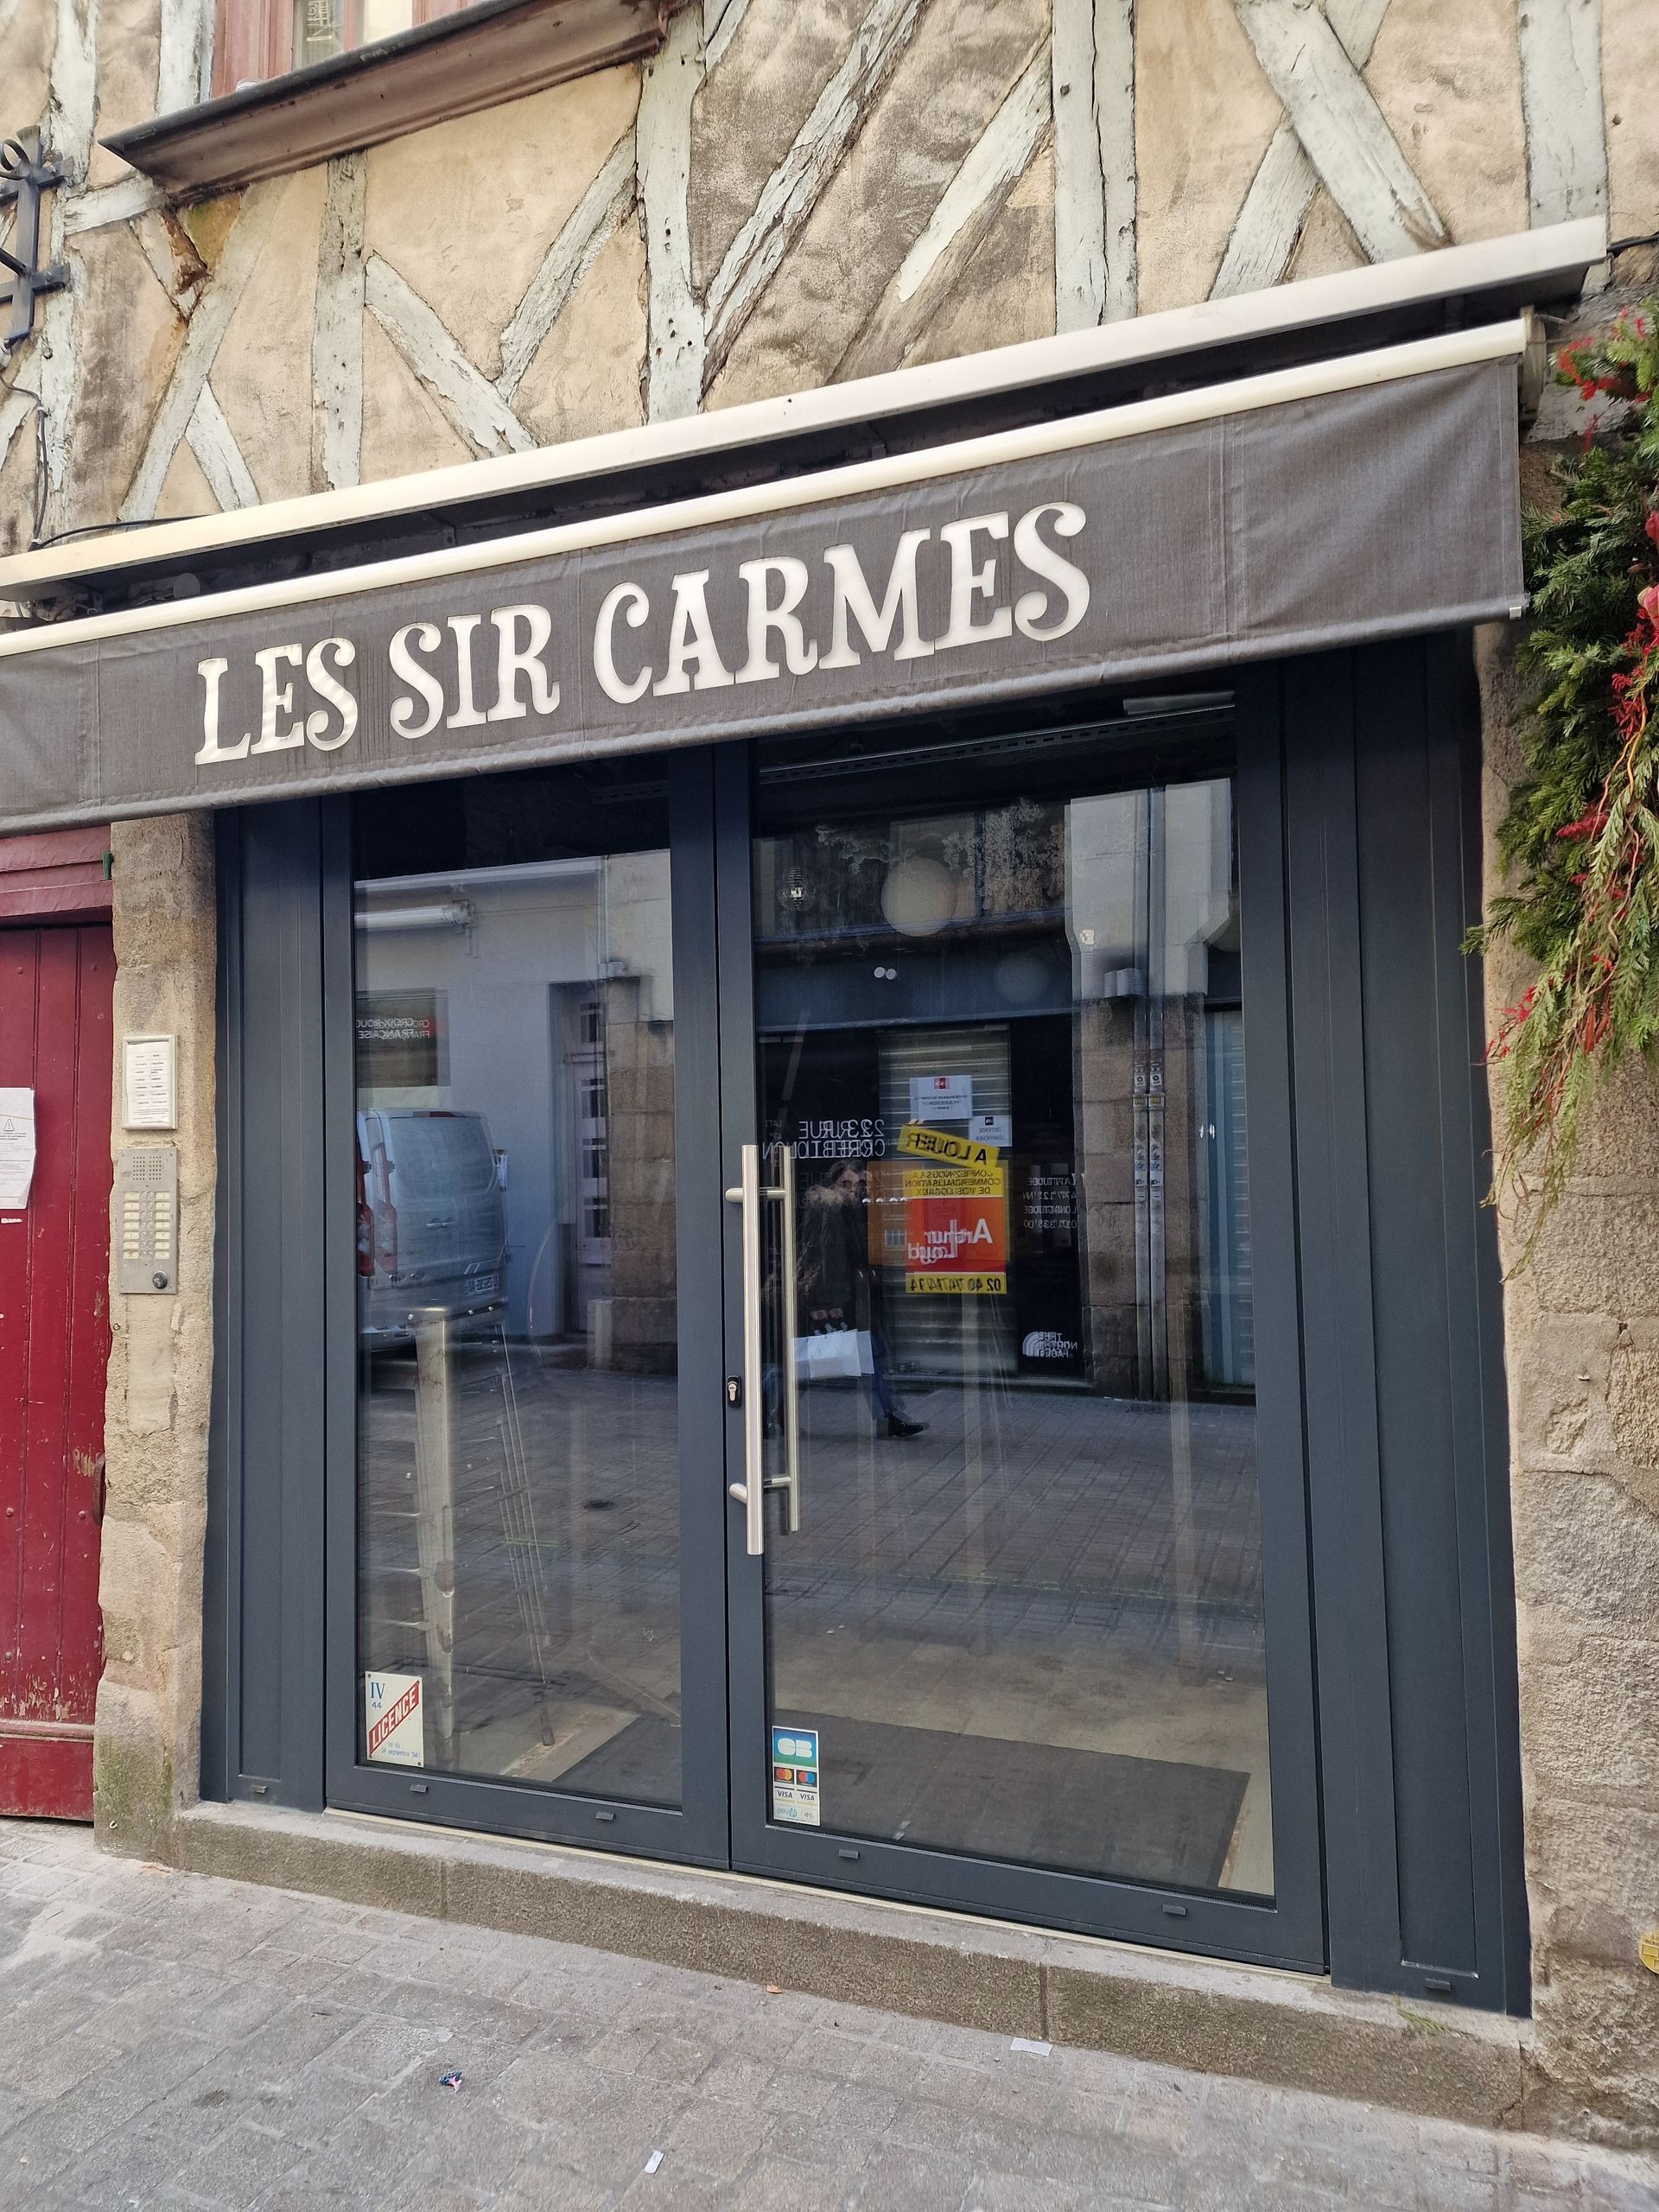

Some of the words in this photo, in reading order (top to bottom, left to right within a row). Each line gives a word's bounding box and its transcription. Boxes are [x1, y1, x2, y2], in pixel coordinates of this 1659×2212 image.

[194, 638, 358, 766] LES
[389, 604, 560, 740] SIR
[593, 501, 1090, 704] CARMES
[370, 1682, 385, 1700] IV
[371, 1687, 416, 1750] LICENCE
[778, 1738, 812, 1758] CB
[777, 1789, 793, 1799] VISA
[799, 1793, 816, 1802] VISA
